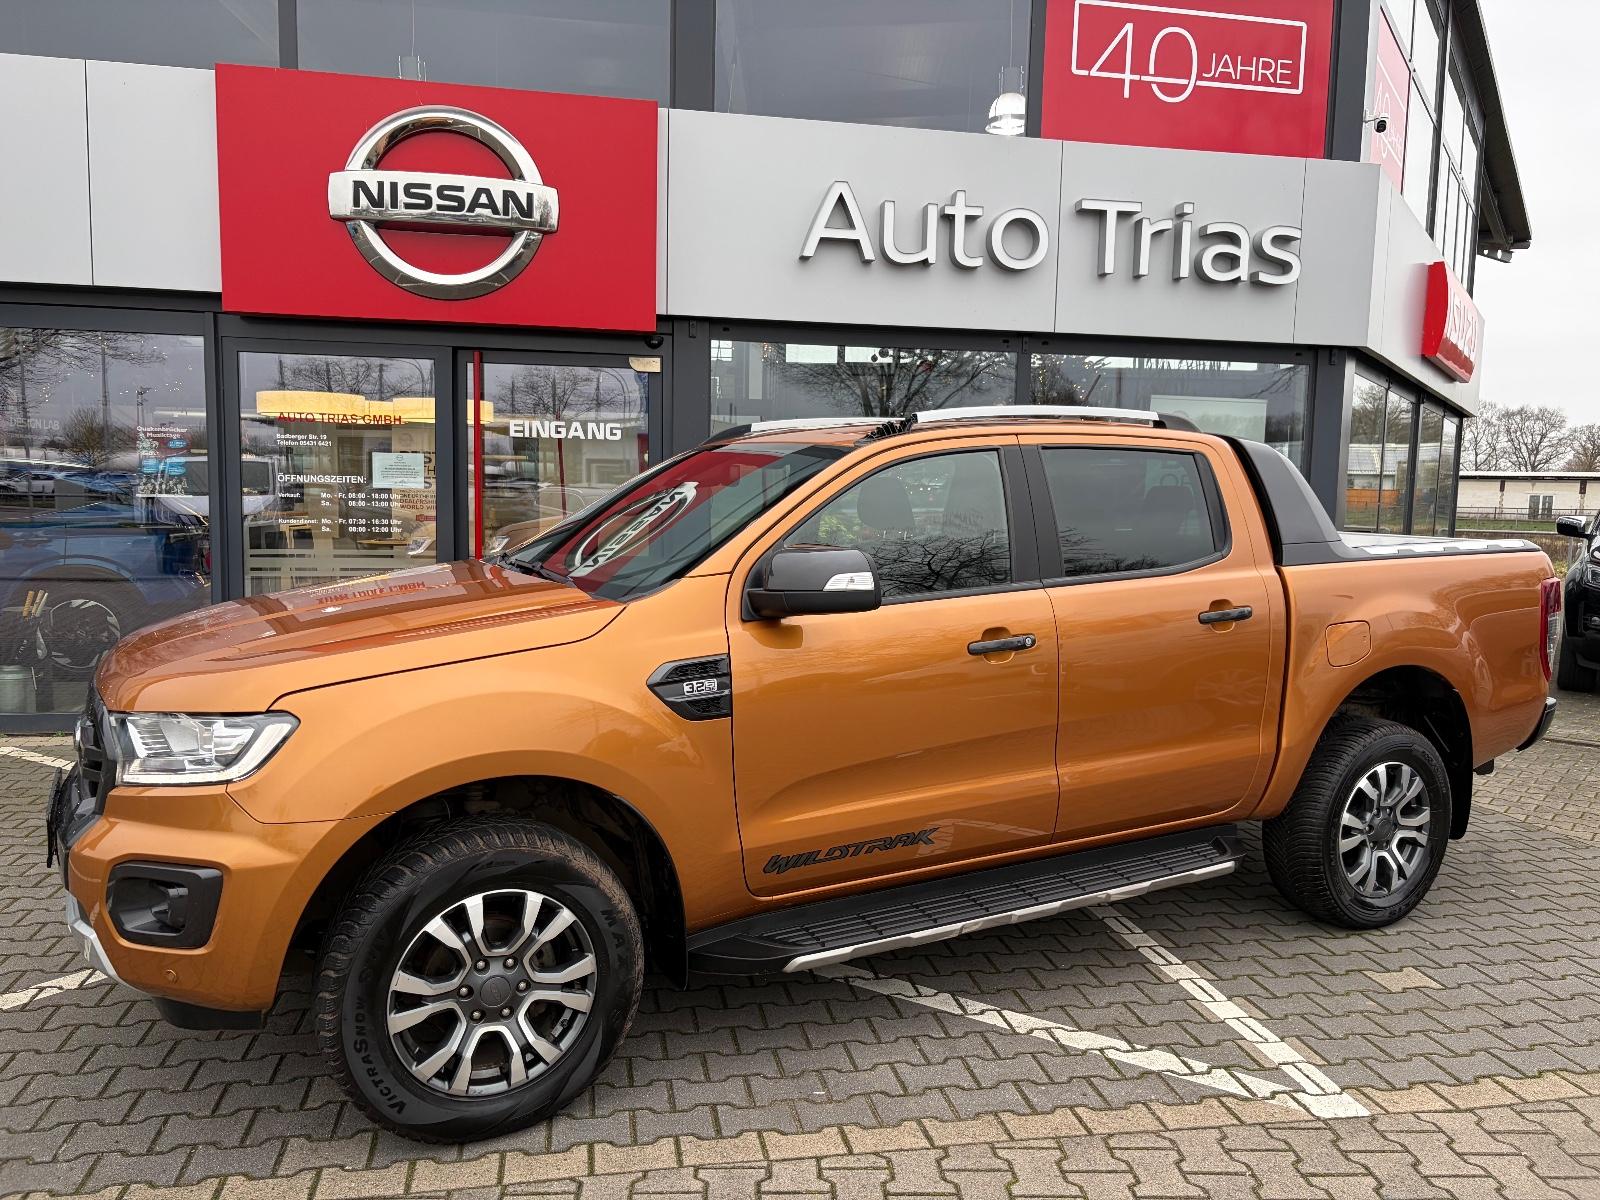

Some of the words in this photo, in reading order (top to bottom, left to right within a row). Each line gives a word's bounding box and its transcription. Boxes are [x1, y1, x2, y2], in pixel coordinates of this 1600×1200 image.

[1090, 22, 1198, 103] 40
[1202, 53, 1293, 84] JAHRE
[352, 180, 534, 220] NISSAN
[799, 180, 1050, 272] Auto
[1075, 197, 1303, 287] Trias
[278, 412, 316, 423] AUTO
[320, 413, 358, 424] TRIAS
[363, 415, 403, 425] GMBH
[509, 419, 622, 441] EINGANG
[277, 472, 367, 484] ÖFFNUNGSZEITEN:
[762, 826, 942, 875] WILDTRAK
